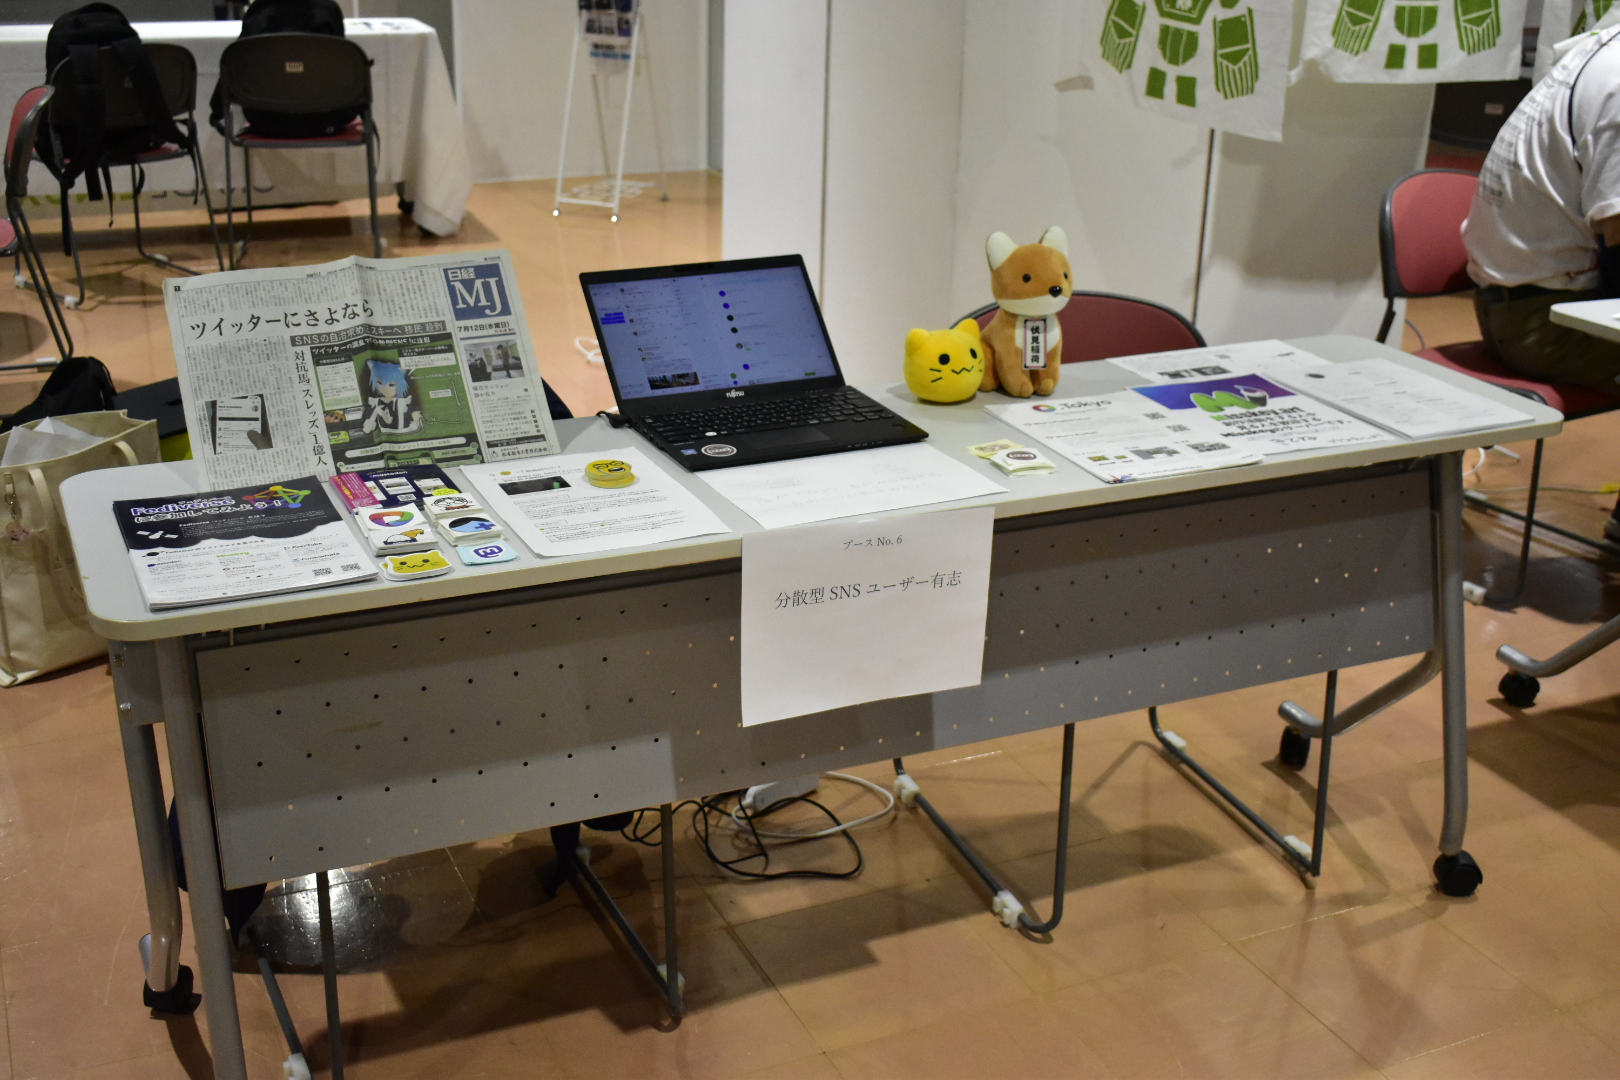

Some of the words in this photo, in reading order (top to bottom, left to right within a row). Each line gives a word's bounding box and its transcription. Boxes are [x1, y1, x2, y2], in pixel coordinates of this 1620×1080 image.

[447, 267, 476, 280] 日経
[450, 277, 502, 315] MJ
[190, 299, 373, 339] ツイッターにさよなら
[1031, 326, 1040, 363] 伏見稲荷
[131, 498, 236, 516] Fediverse
[843, 538, 873, 551] ブース
[877, 536, 894, 547] No.
[896, 535, 903, 544] 6
[774, 586, 825, 610] 分散型
[829, 583, 861, 601] SNS
[866, 570, 962, 593] ユーザー有志
